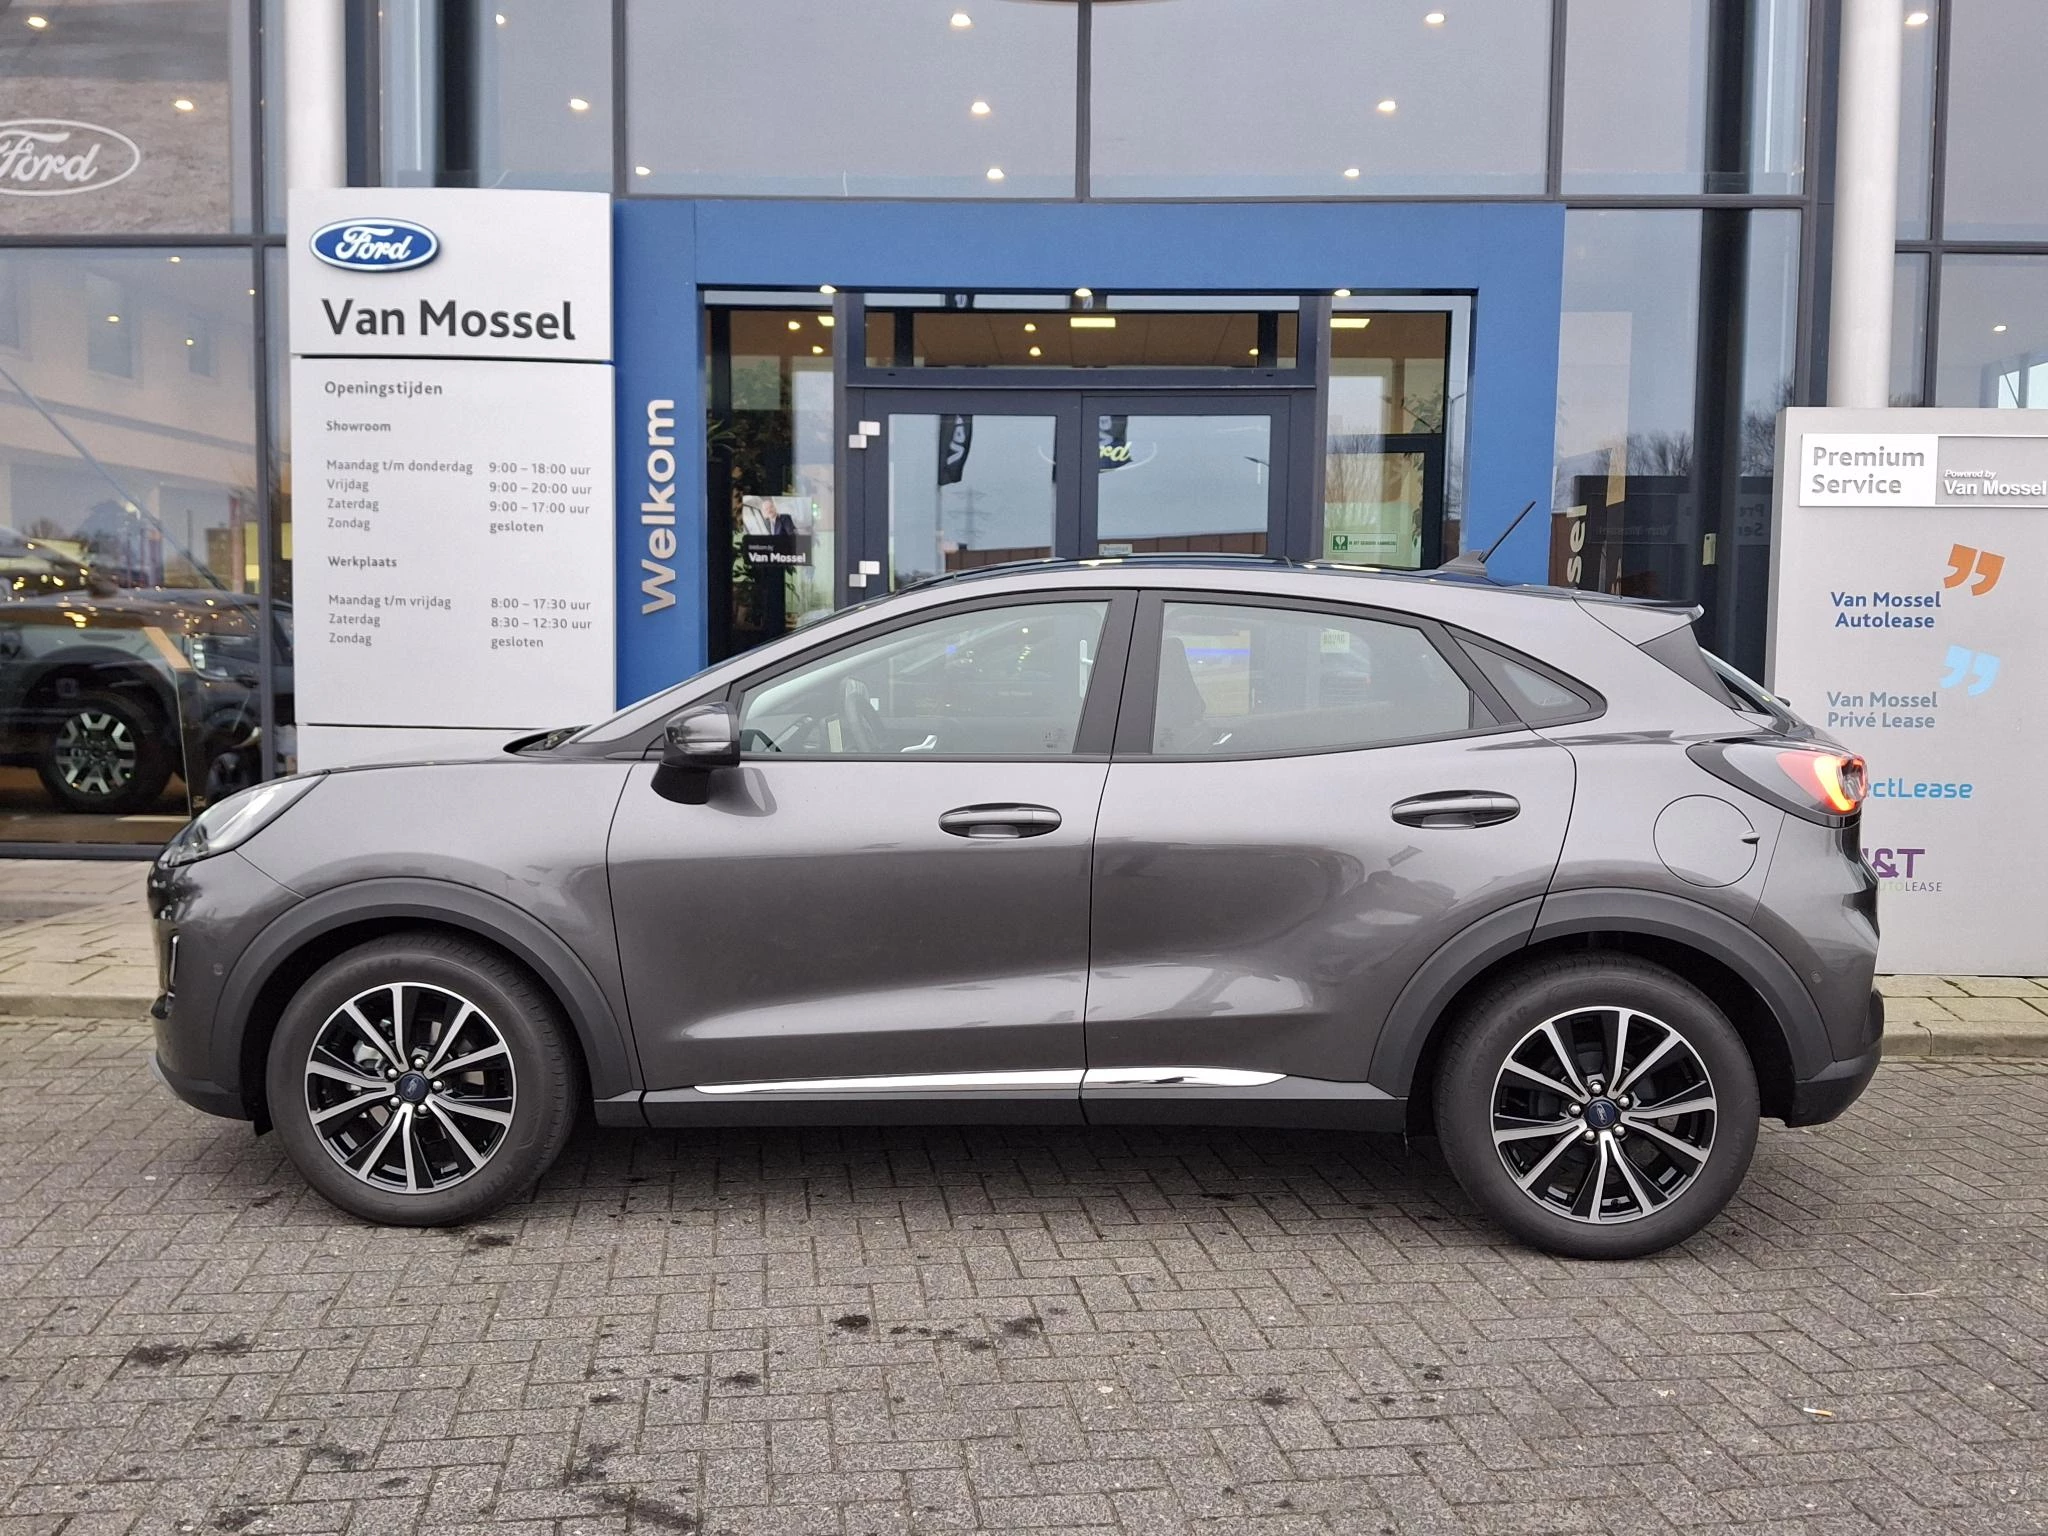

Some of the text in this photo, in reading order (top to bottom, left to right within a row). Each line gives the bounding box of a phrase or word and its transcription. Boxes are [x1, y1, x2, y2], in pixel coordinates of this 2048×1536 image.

[335, 226, 412, 259] Ford
[321, 298, 576, 341] Van Mossel
[324, 380, 443, 398] Openingstijden
[325, 420, 392, 432] Showroom
[1099, 441, 1132, 461] rd
[1812, 445, 1925, 467] Premium
[326, 458, 474, 476] Maandag t/m donderdag
[488, 461, 518, 474] 9:00
[531, 462, 567, 475] 18:00
[569, 466, 591, 476] uur
[326, 478, 370, 494] Vrijdag
[488, 481, 518, 494] 9:00
[531, 482, 568, 495] 20:00
[571, 486, 593, 495] uur
[1811, 473, 1902, 494] Service
[1944, 480, 2047, 496] Van Mossel
[327, 497, 380, 513] Zaterdag
[488, 500, 518, 513] 9:00
[531, 501, 566, 514] 17:00
[569, 505, 591, 515] uur
[641, 400, 678, 616] Welkom
[327, 516, 371, 532] Zondag
[489, 520, 545, 535] gesloten
[1566, 504, 1588, 586] sel
[327, 556, 398, 571] Werkplaats
[748, 552, 806, 563] Van Mossel
[328, 594, 452, 611] Maandag t/m vrijdag
[490, 597, 519, 610] 8:00
[533, 598, 567, 611] 17:30
[570, 601, 592, 611] uur
[1830, 590, 1942, 608] Van Mossel
[328, 612, 381, 628] Zaterdag
[490, 616, 519, 628] 8:30
[533, 617, 568, 629] 12:30
[571, 621, 593, 630] uur
[1834, 611, 1936, 629] Autolease
[328, 631, 373, 647] Zondag
[490, 635, 545, 650] gesloten
[1826, 690, 1939, 708] Van Mossel
[1827, 711, 1936, 729] Privé Lease
[1868, 778, 1974, 798] ctLease
[1879, 881, 1943, 892] UTOLEASE
